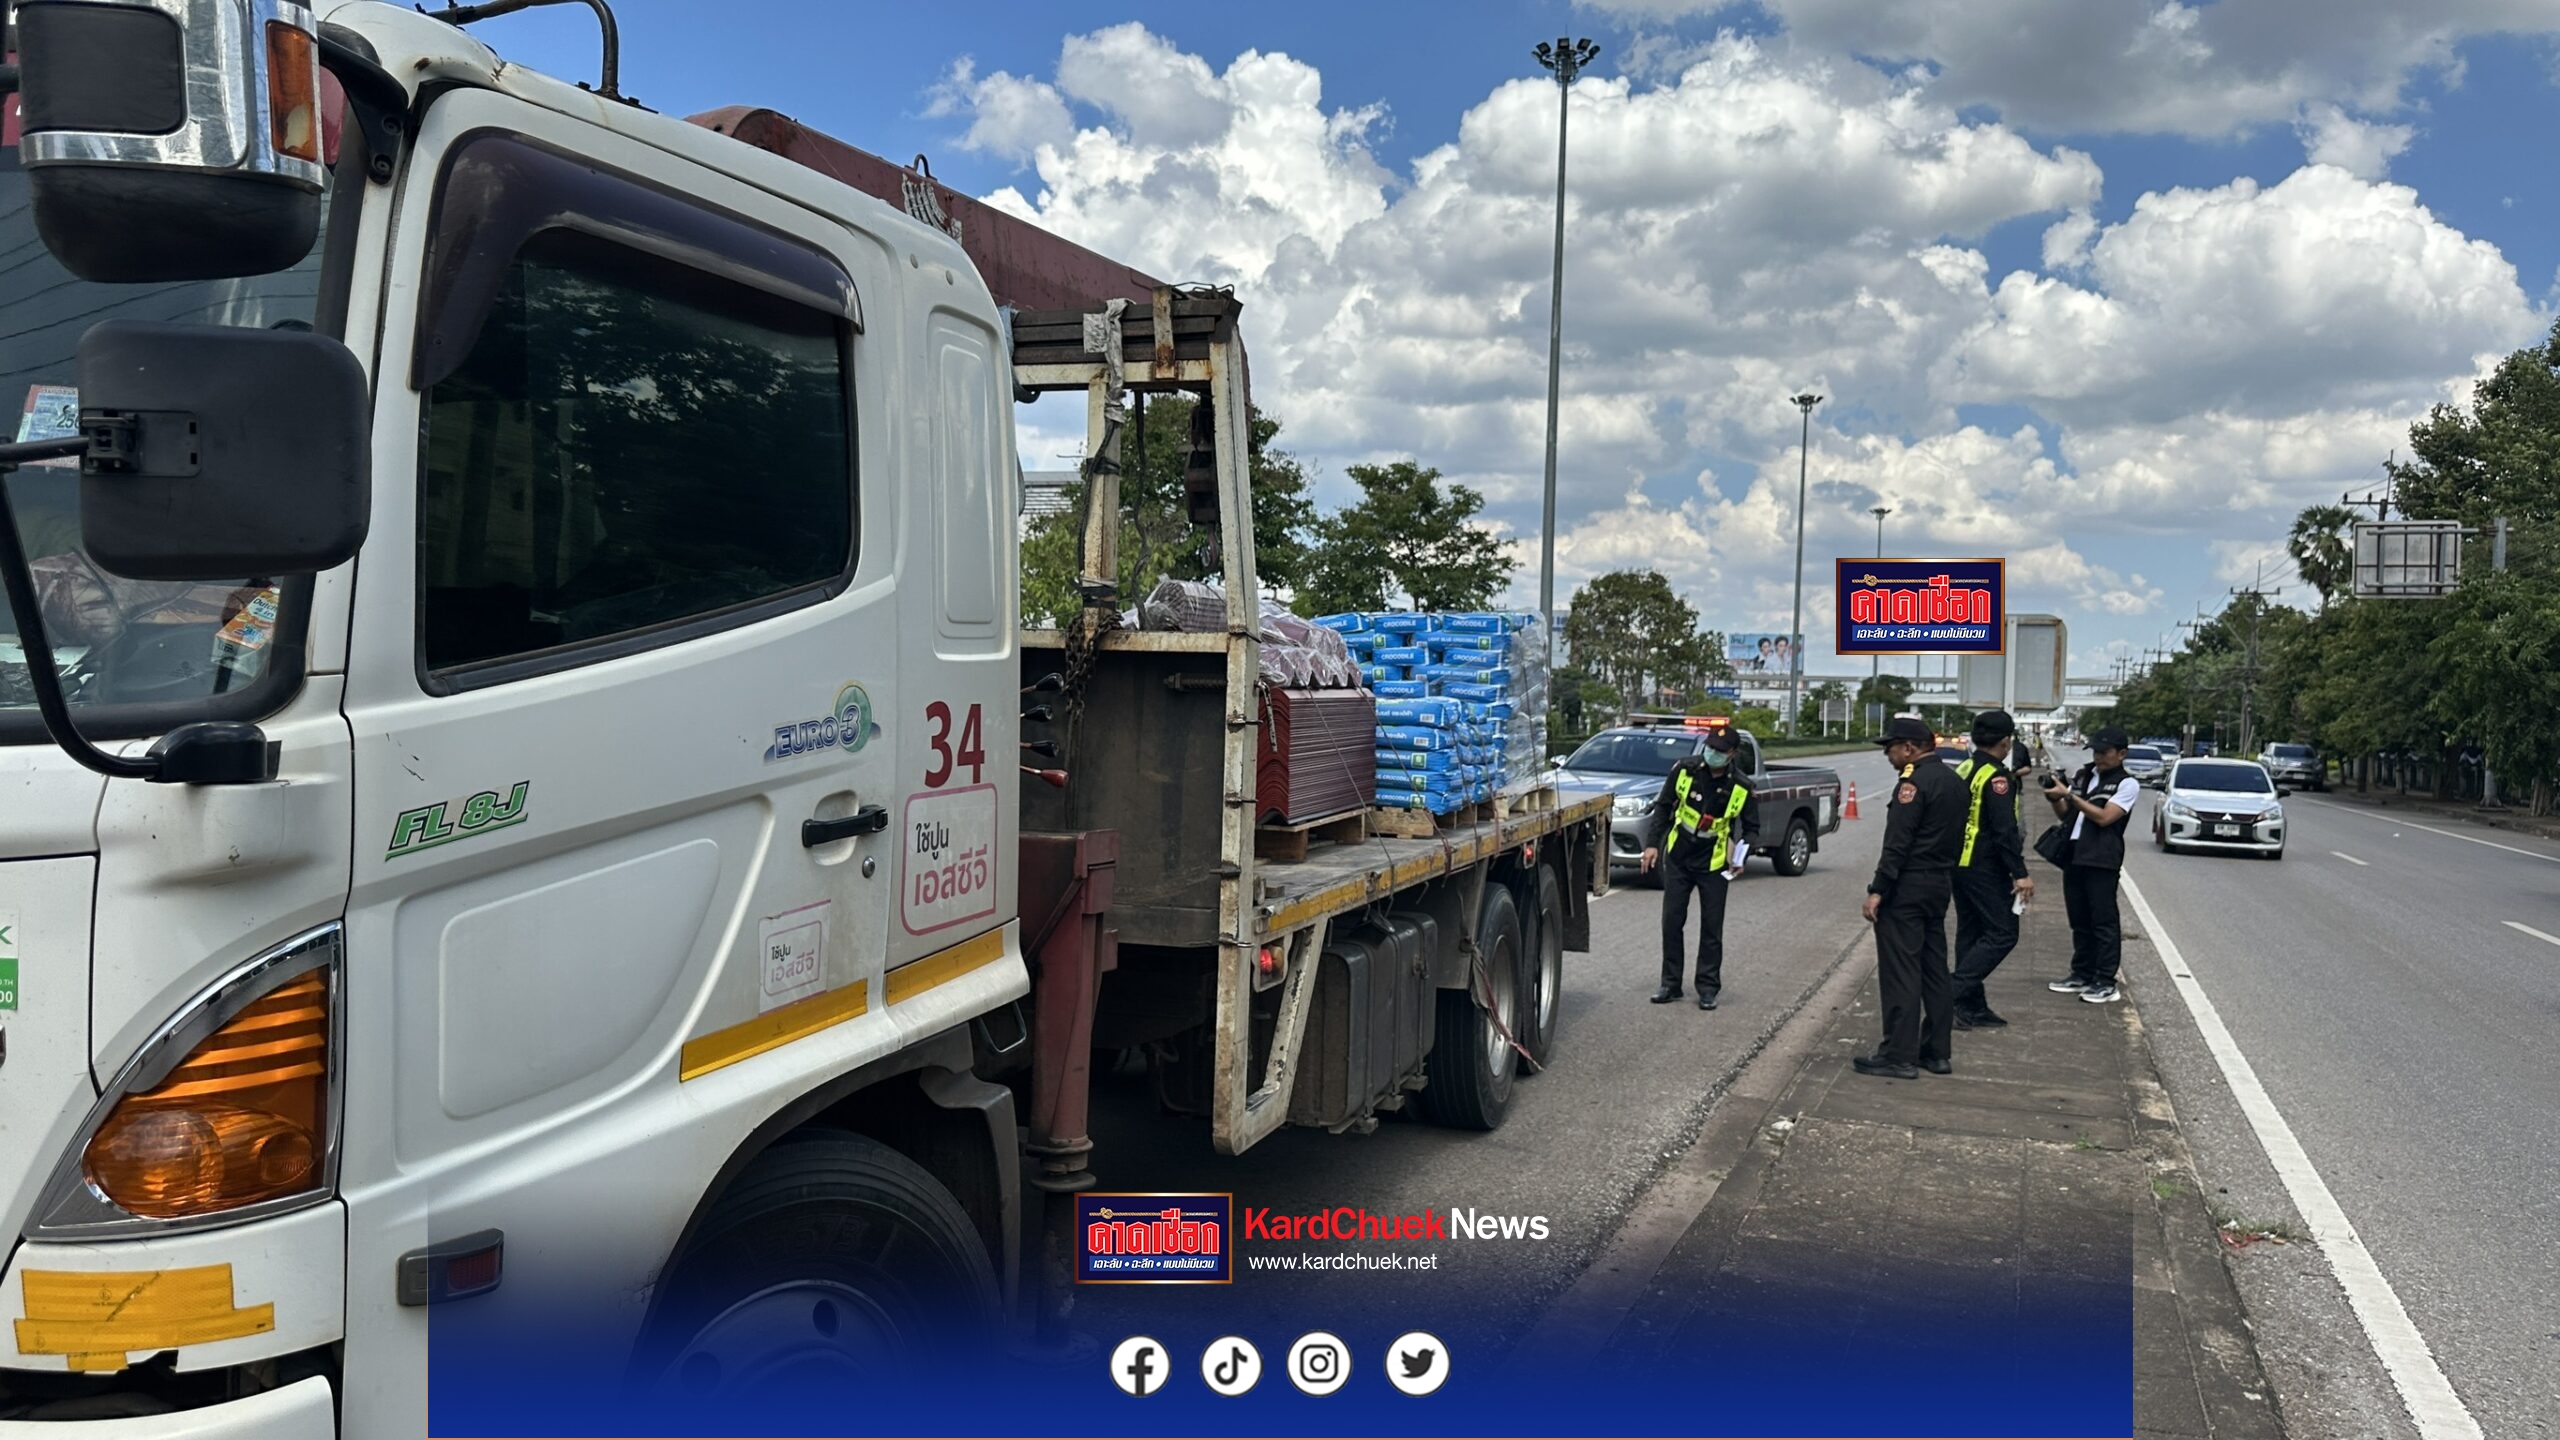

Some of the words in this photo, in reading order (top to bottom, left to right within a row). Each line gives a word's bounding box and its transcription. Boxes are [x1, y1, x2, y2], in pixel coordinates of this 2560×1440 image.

[1382, 619, 1417, 628] CROCODILE
[1451, 619, 1488, 628] CROCODILE
[1380, 651, 1415, 660] CROCODILE
[1452, 653, 1487, 663] CROCODILE
[1380, 686, 1415, 695] CROCODILE
[1450, 687, 1486, 698] CROCODILE
[924, 700, 985, 789] 34
[389, 801, 454, 850] FL
[915, 821, 950, 860] ใช้ปูน
[914, 843, 988, 906] เอสซีจี
[771, 943, 791, 962] ใช้ปูน
[771, 948, 815, 983] เอสซีจี
